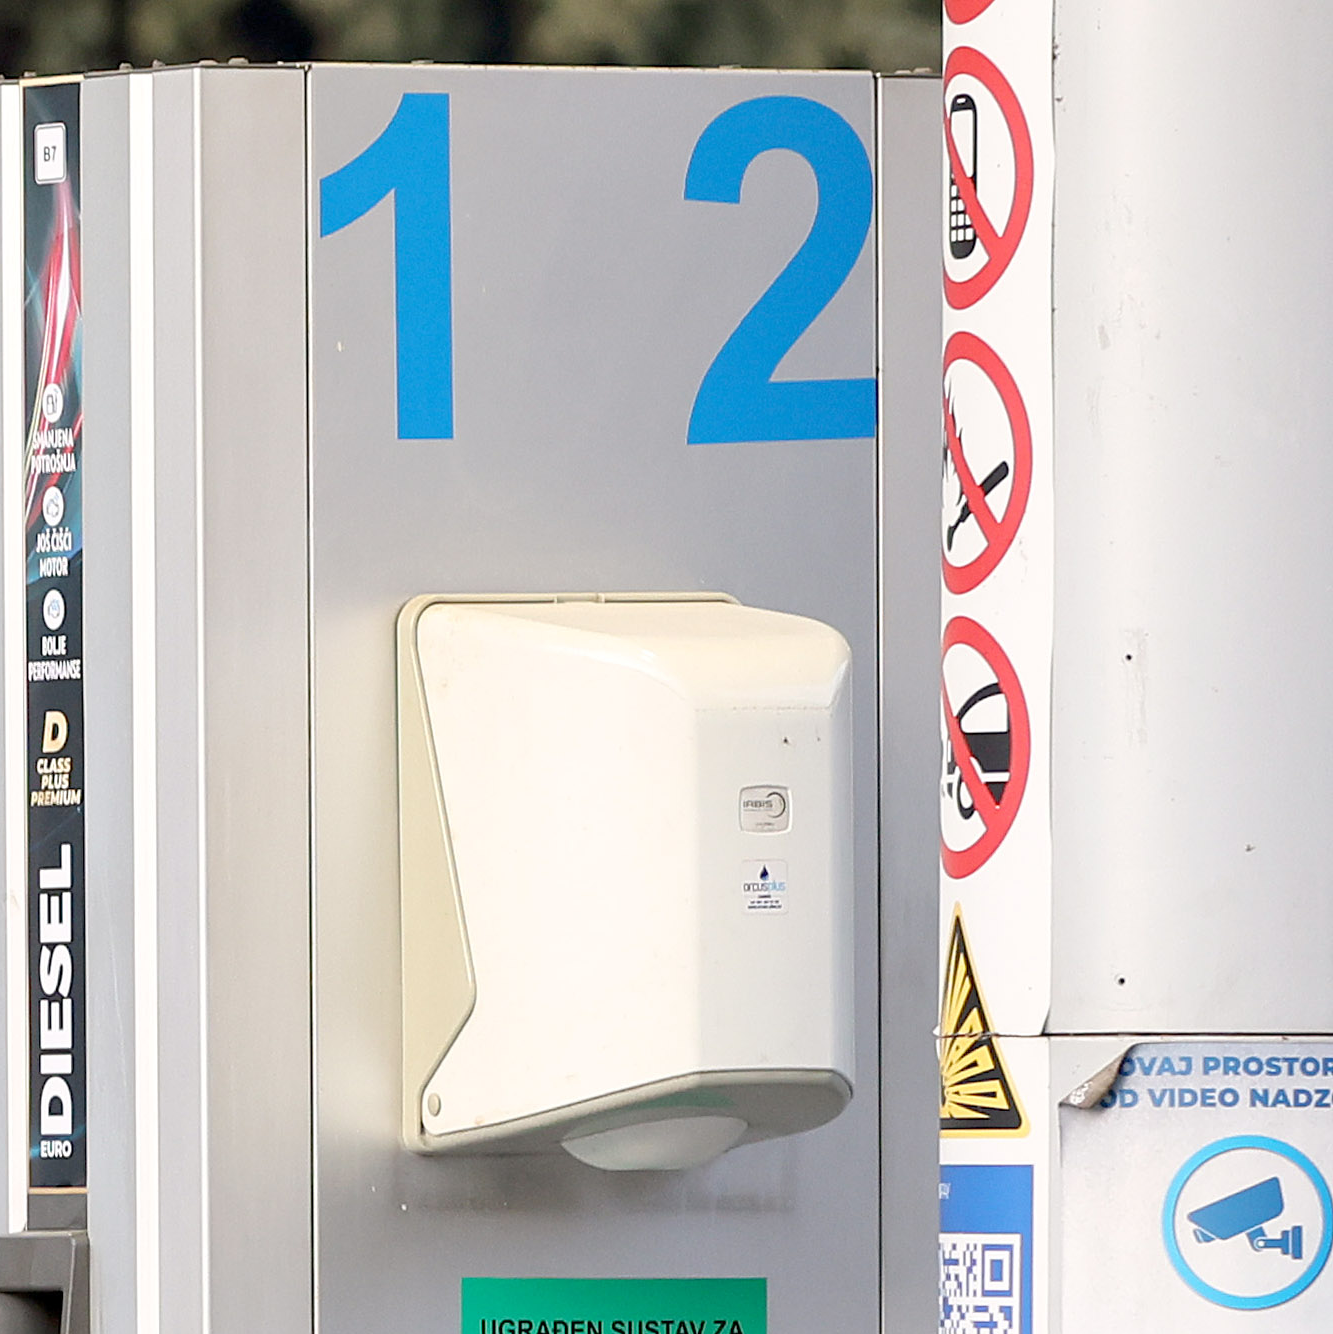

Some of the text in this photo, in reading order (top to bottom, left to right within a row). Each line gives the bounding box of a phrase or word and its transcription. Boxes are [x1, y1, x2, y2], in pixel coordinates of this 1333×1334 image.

[43, 146, 57, 162] B7
[320, 93, 453, 439] 1
[684, 95, 877, 445] 2
[33, 428, 73, 449] SMANJENA
[36, 528, 51, 552] JOŠ
[39, 557, 68, 577] MOTOR
[41, 636, 67, 656] BOLJE
[29, 659, 81, 680] PERFORMANSE
[43, 710, 68, 754] D
[37, 758, 71, 774] CLASS
[41, 774, 69, 789] PLUS
[31, 789, 81, 807] PREMIUM
[39, 843, 73, 1137] DIESEL
[1119, 1056, 1193, 1076] OVAJ
[1100, 1088, 1333, 1108] OD VIDEO NADZ
[40, 1140, 71, 1160] EURO
